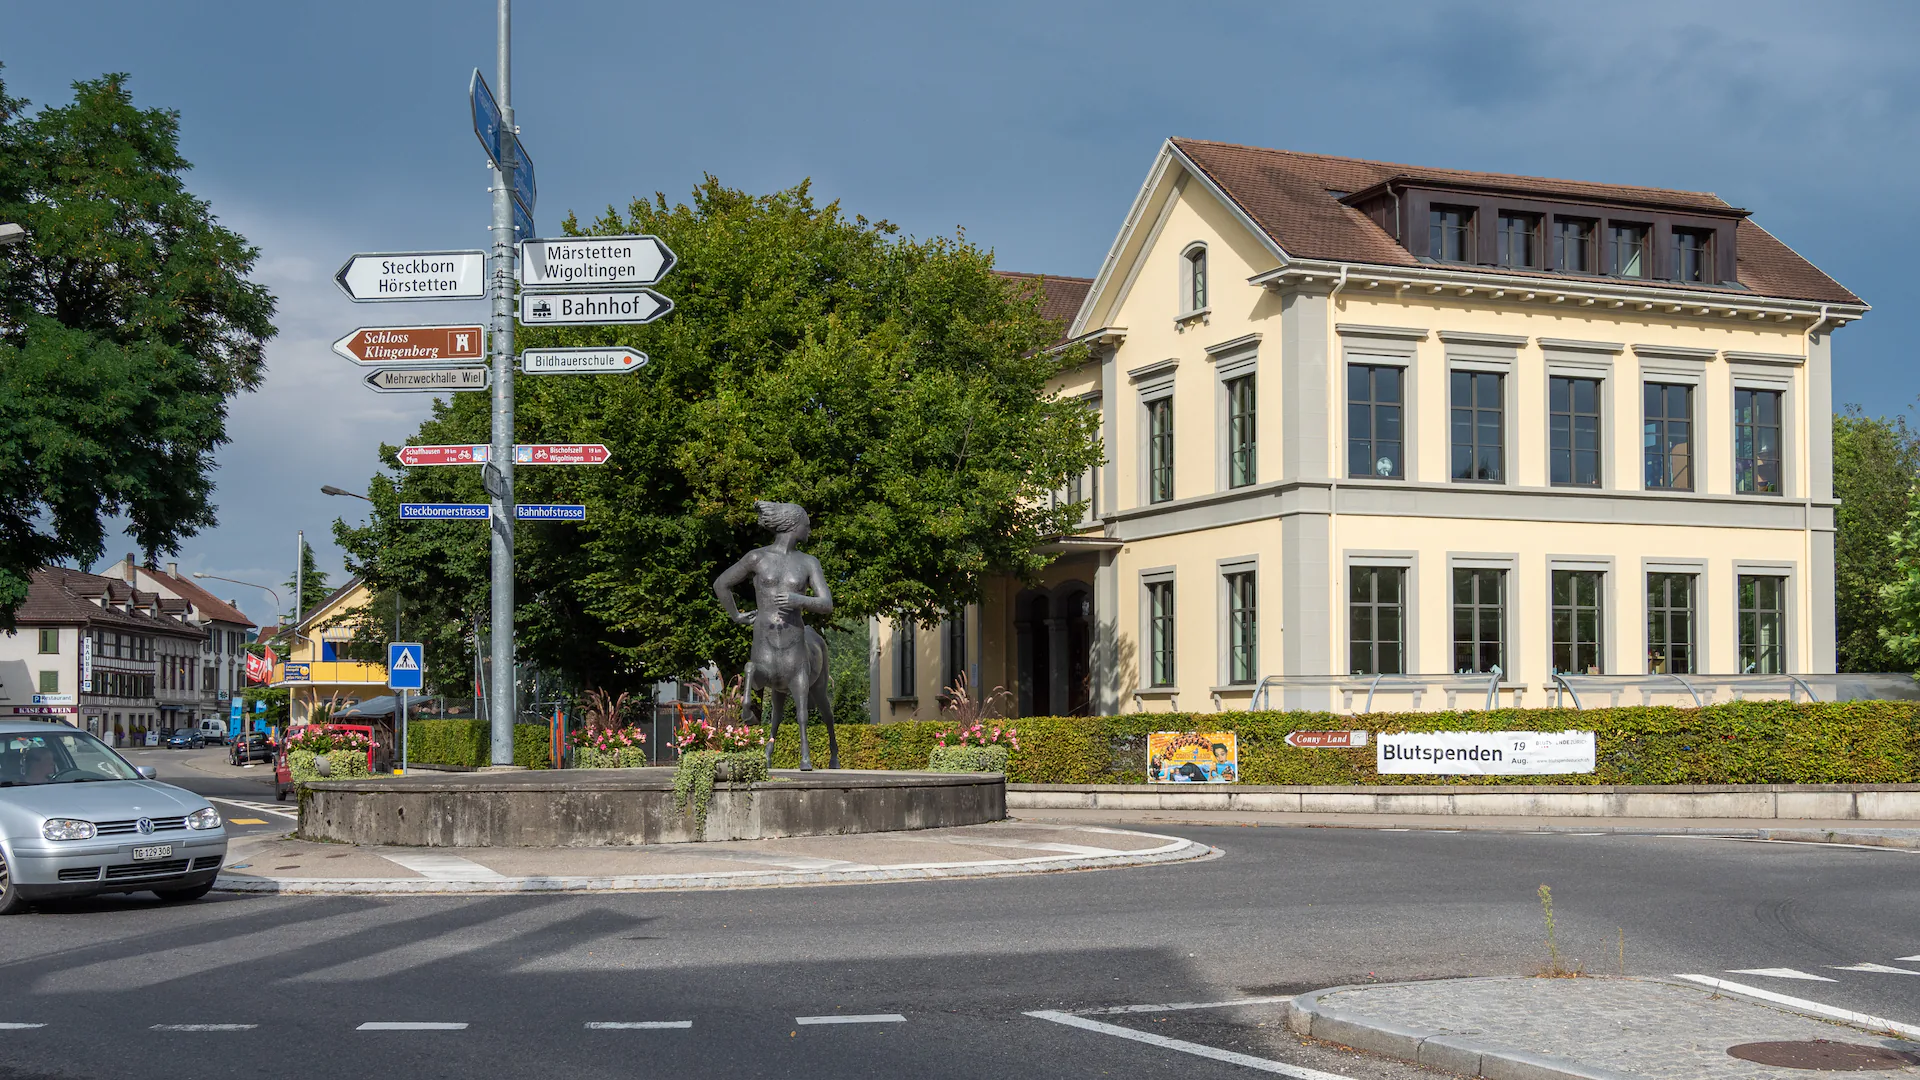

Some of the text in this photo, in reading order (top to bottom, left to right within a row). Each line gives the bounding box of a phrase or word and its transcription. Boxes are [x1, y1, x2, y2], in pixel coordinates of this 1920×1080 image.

[548, 245, 631, 260] Märstetten
[382, 259, 454, 275] Steckborn
[544, 263, 636, 281] Wigoltingen
[379, 278, 457, 293] Hörstetten
[563, 296, 640, 315] Bahnhof
[364, 332, 409, 344] Schloss
[364, 345, 439, 360] Klingenberg
[535, 355, 615, 367] Bildhauerschule
[385, 372, 481, 385] Mehrzweckhalle Wiel
[550, 455, 584, 463] Wigoltingen
[404, 506, 486, 516] Steckbornerstrasse
[518, 506, 583, 517] Bahnhofstrasse
[1296, 734, 1321, 744] Conny
[1327, 734, 1348, 743] Land
[1513, 741, 1526, 751] 19
[1383, 744, 1503, 764] Blutspenden
[135, 849, 143, 857] TG
[145, 848, 157, 857] 129
